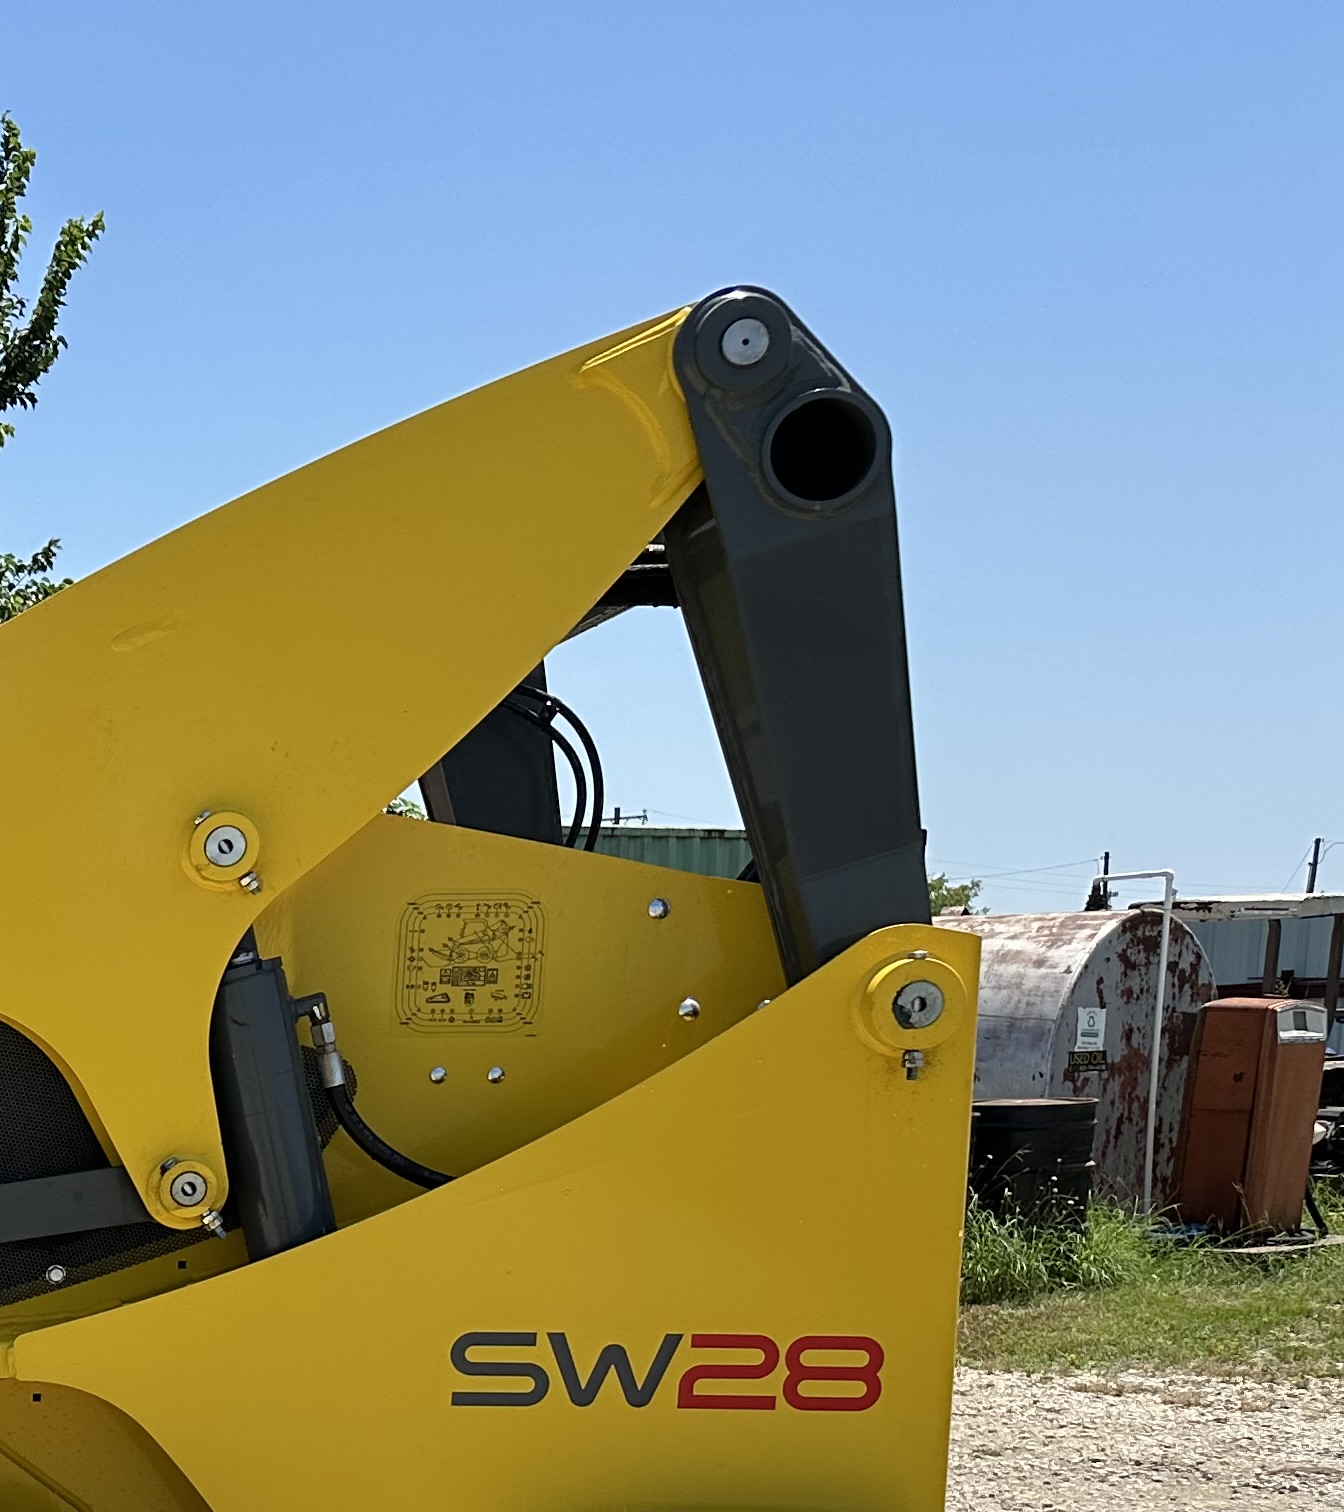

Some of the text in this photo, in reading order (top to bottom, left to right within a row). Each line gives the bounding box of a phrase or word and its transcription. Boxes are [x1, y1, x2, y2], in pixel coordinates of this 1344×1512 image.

[1069, 1052, 1105, 1065] USED OIL
[450, 1332, 885, 1412] SW28
